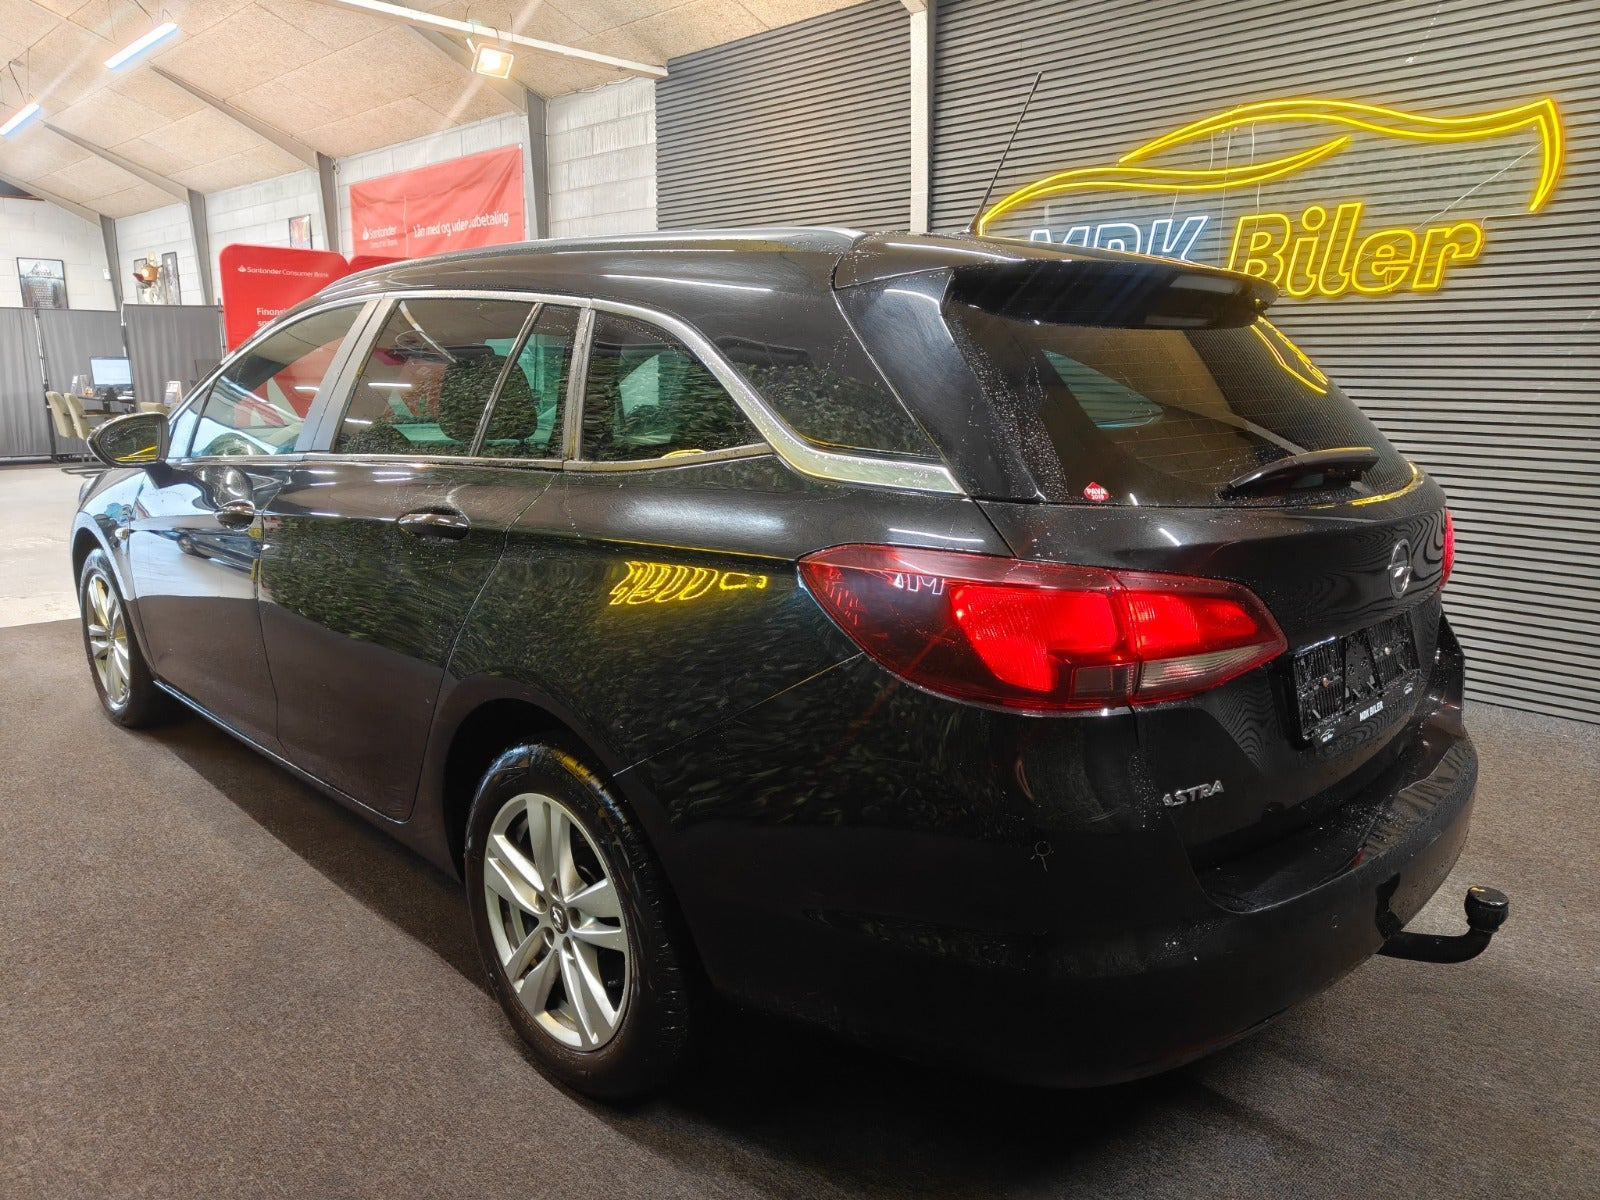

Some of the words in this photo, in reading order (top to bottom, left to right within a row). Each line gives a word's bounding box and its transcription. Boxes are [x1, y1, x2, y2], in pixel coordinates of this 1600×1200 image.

[441, 222, 451, 236] og
[1227, 201, 1484, 297] Biler
[247, 266, 282, 275] Santander
[282, 269, 313, 277] Consumer
[1162, 780, 1225, 807] ASTRA
